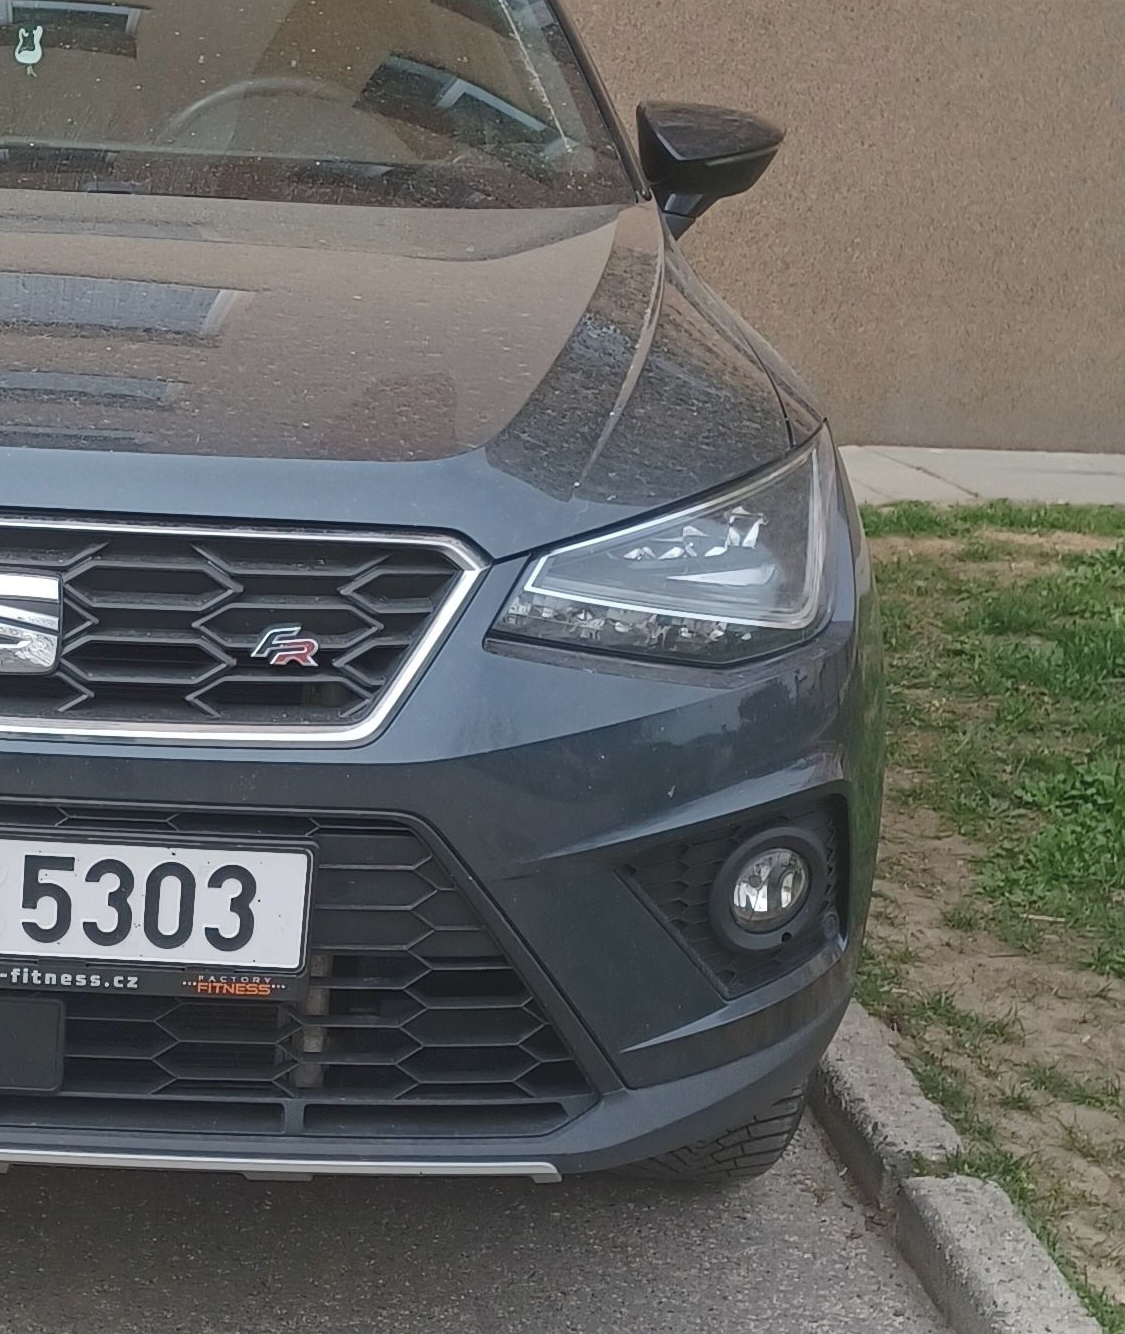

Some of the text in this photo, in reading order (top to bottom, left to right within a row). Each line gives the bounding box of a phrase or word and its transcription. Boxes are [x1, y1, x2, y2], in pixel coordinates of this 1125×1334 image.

[251, 626, 319, 667] FR
[21, 854, 257, 952] 5303
[197, 982, 272, 996] FITNESS
[198, 975, 272, 984] FACTORY
